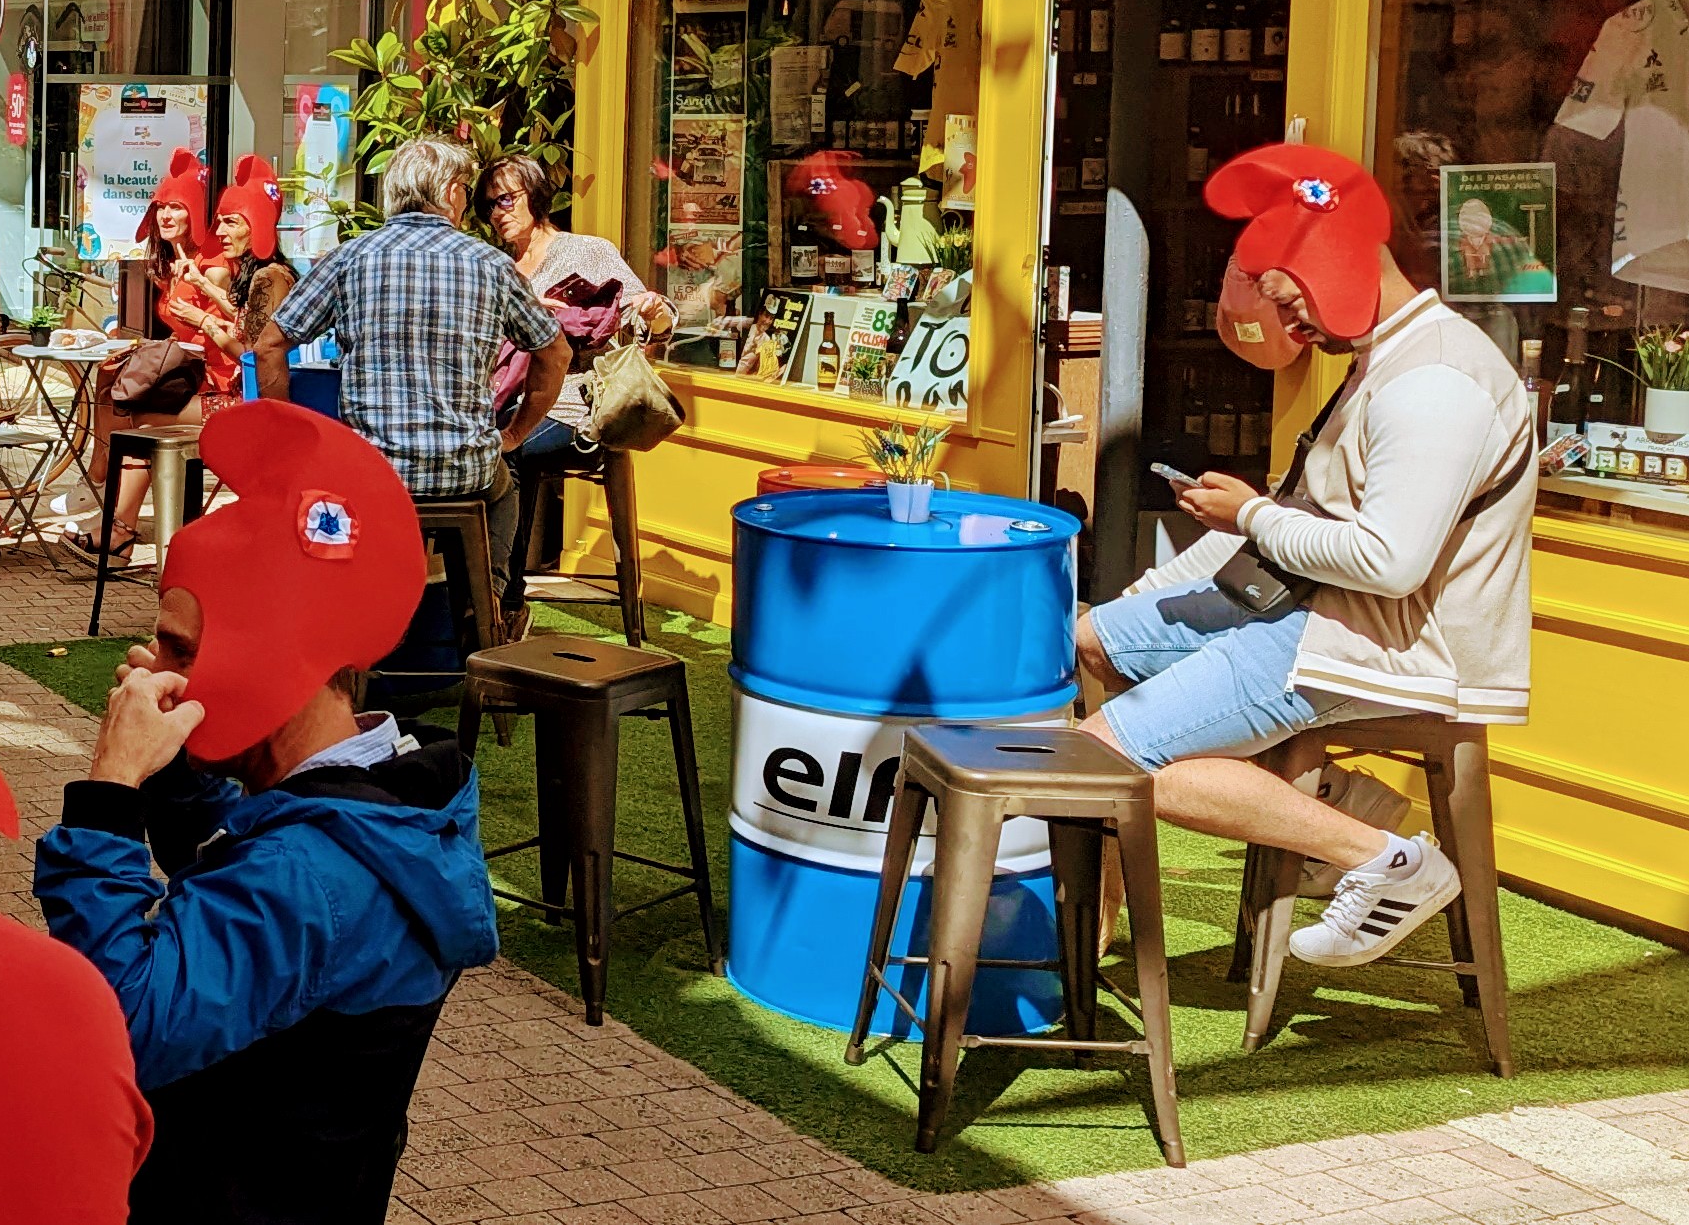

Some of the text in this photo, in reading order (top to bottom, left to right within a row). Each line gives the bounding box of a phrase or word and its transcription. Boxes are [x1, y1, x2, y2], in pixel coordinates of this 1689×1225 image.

[133, 160, 152, 173] Ici,
[103, 174, 158, 187] la beauté
[102, 188, 156, 200] dans cha
[119, 203, 147, 216] voya
